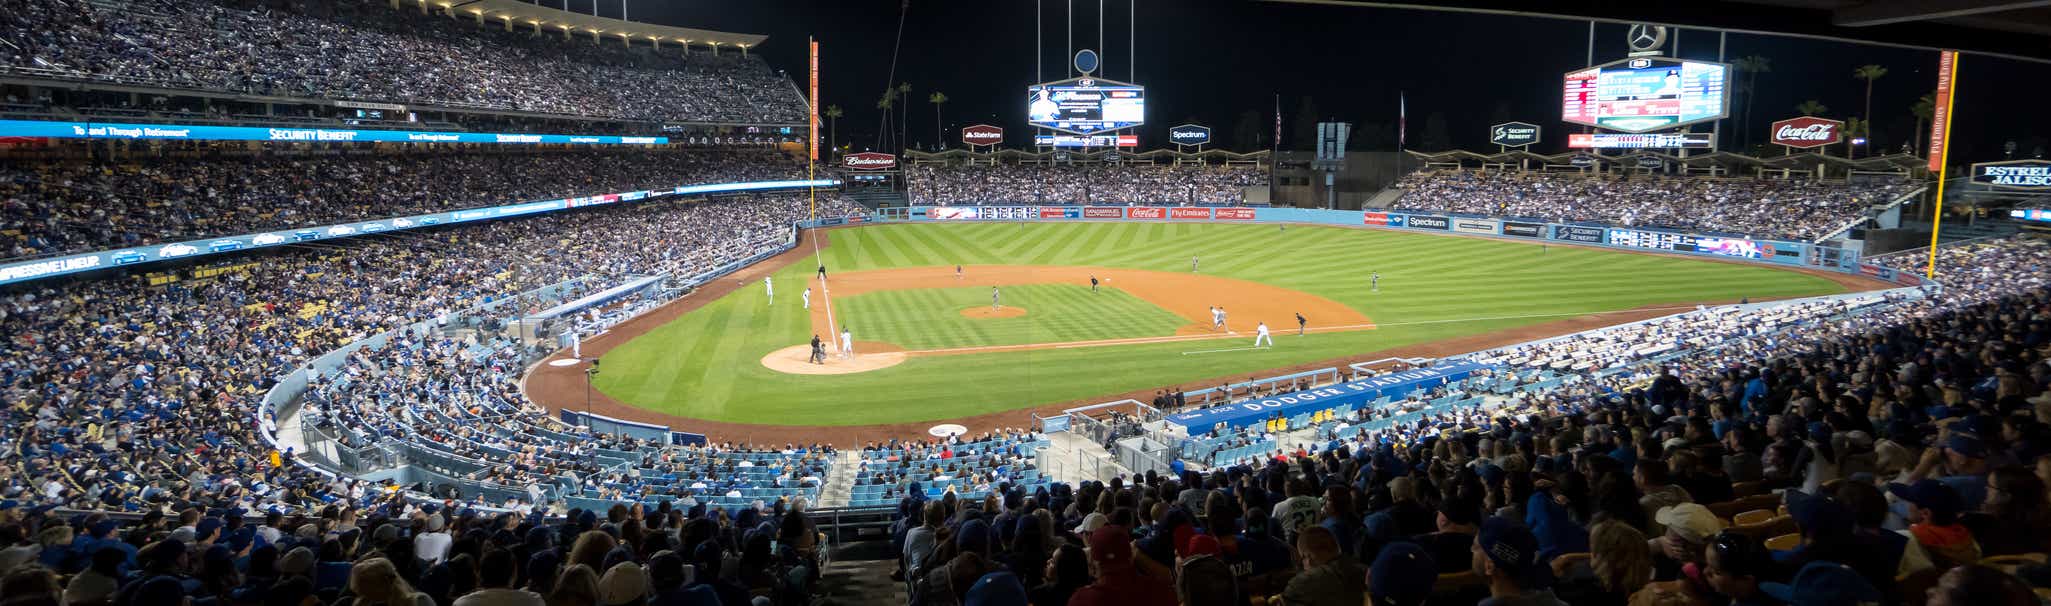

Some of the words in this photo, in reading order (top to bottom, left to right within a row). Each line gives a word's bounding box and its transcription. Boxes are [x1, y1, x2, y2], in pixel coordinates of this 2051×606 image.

[73, 126, 85, 135] To
[88, 127, 106, 135] and
[108, 127, 143, 138] Through
[269, 128, 315, 140] SECURITY
[1173, 131, 1204, 139] Spectrum
[1776, 124, 1834, 140] Coca-Cola
[845, 156, 894, 165] Budweiser
[1172, 208, 1182, 217] Fly
[1410, 217, 1445, 227] Spectrum
[1243, 388, 1344, 411] DODGER
[1346, 369, 1440, 391] STADIUM
